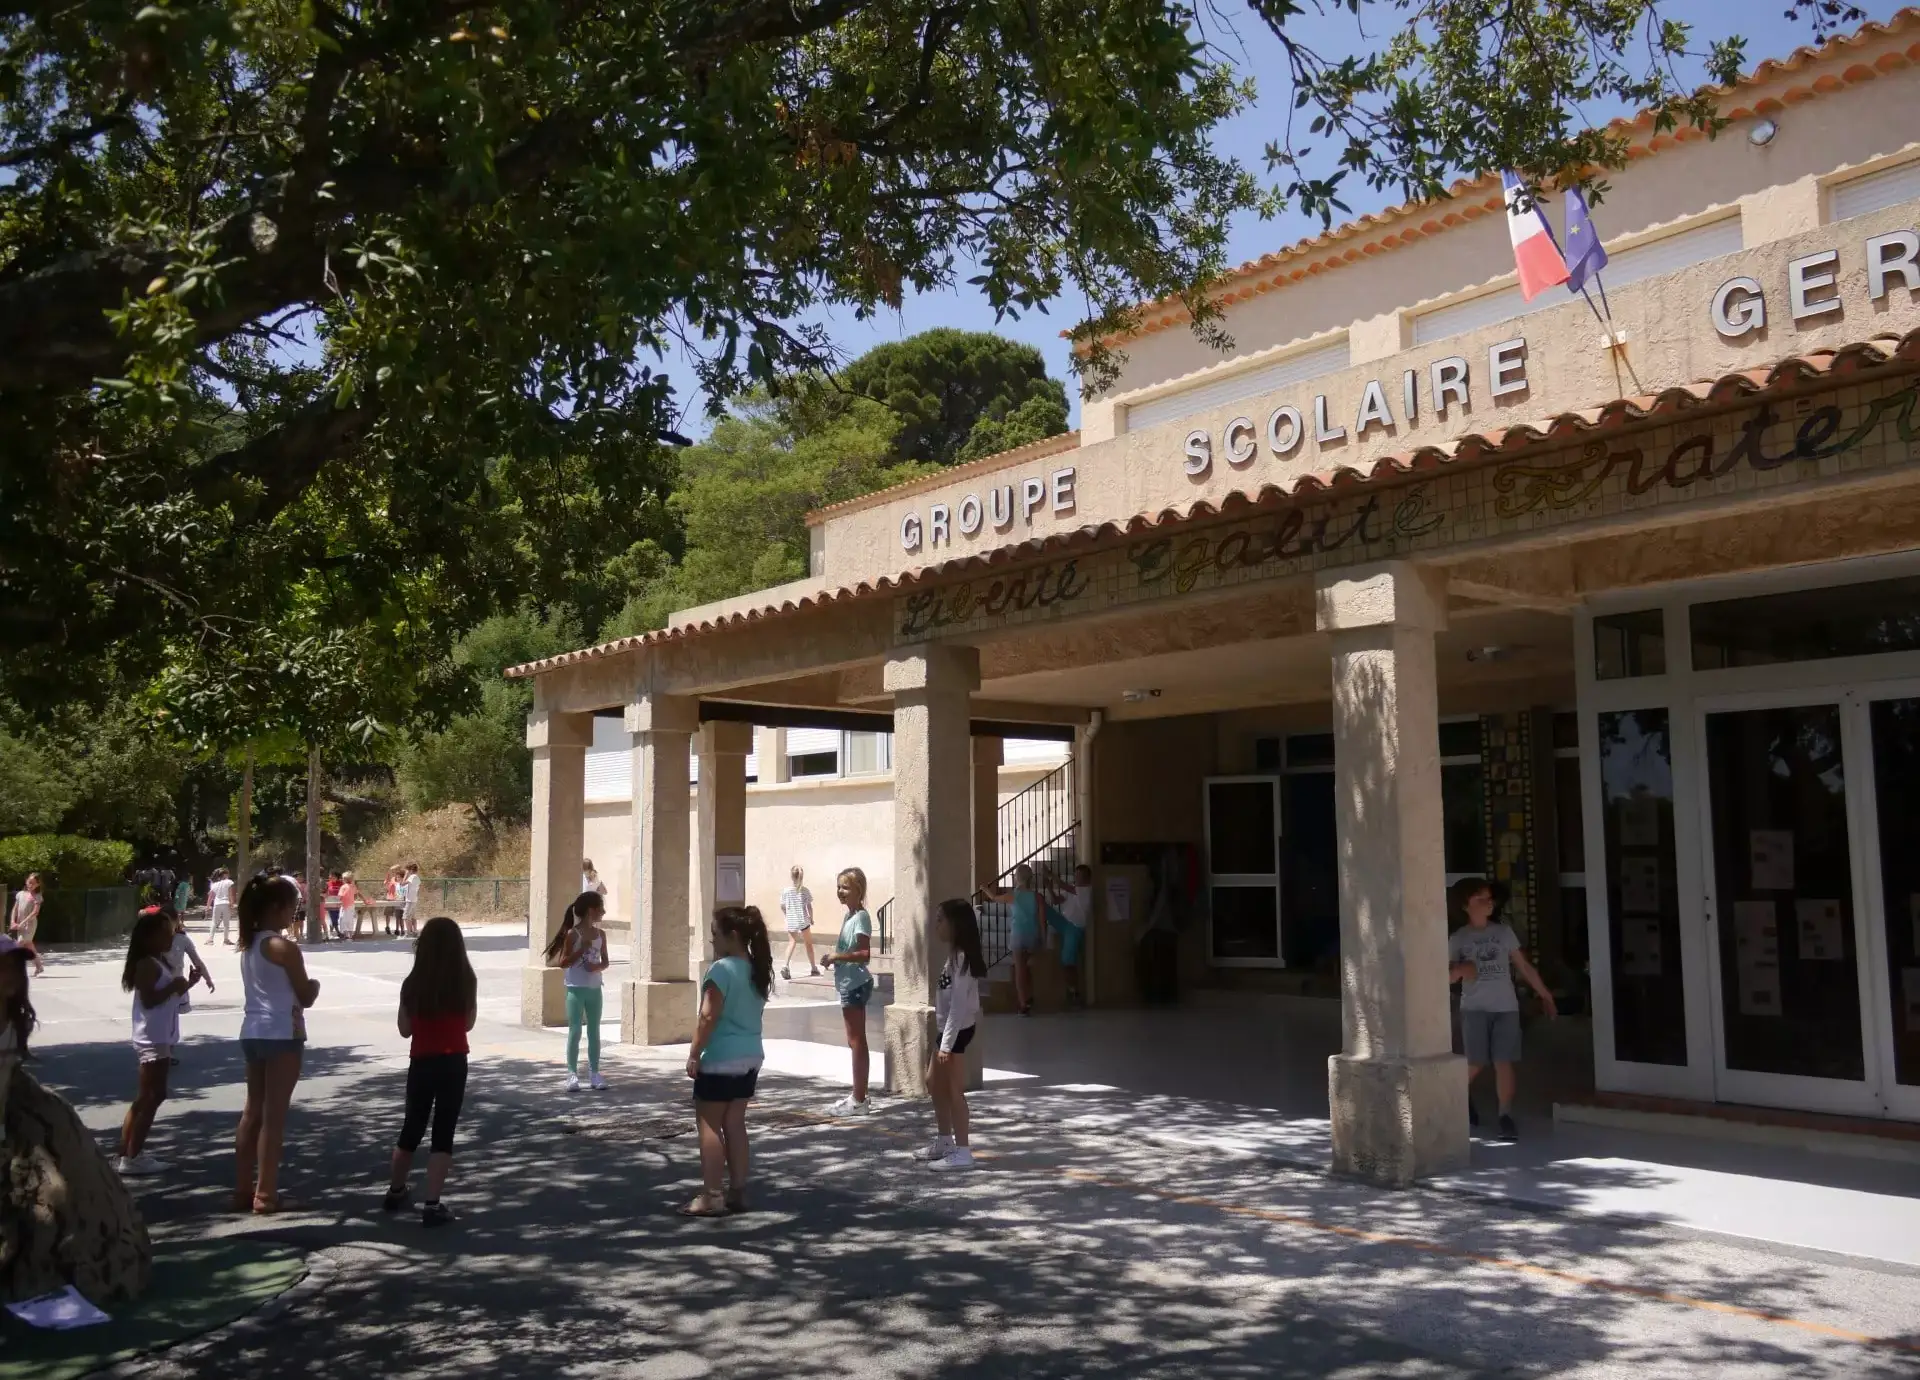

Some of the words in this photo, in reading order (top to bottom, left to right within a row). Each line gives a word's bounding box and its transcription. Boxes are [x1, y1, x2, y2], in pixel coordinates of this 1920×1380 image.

[901, 467, 1076, 550] GROUPE
[1184, 337, 1528, 476] SCOLAIRE
[1711, 228, 1920, 337] GER
